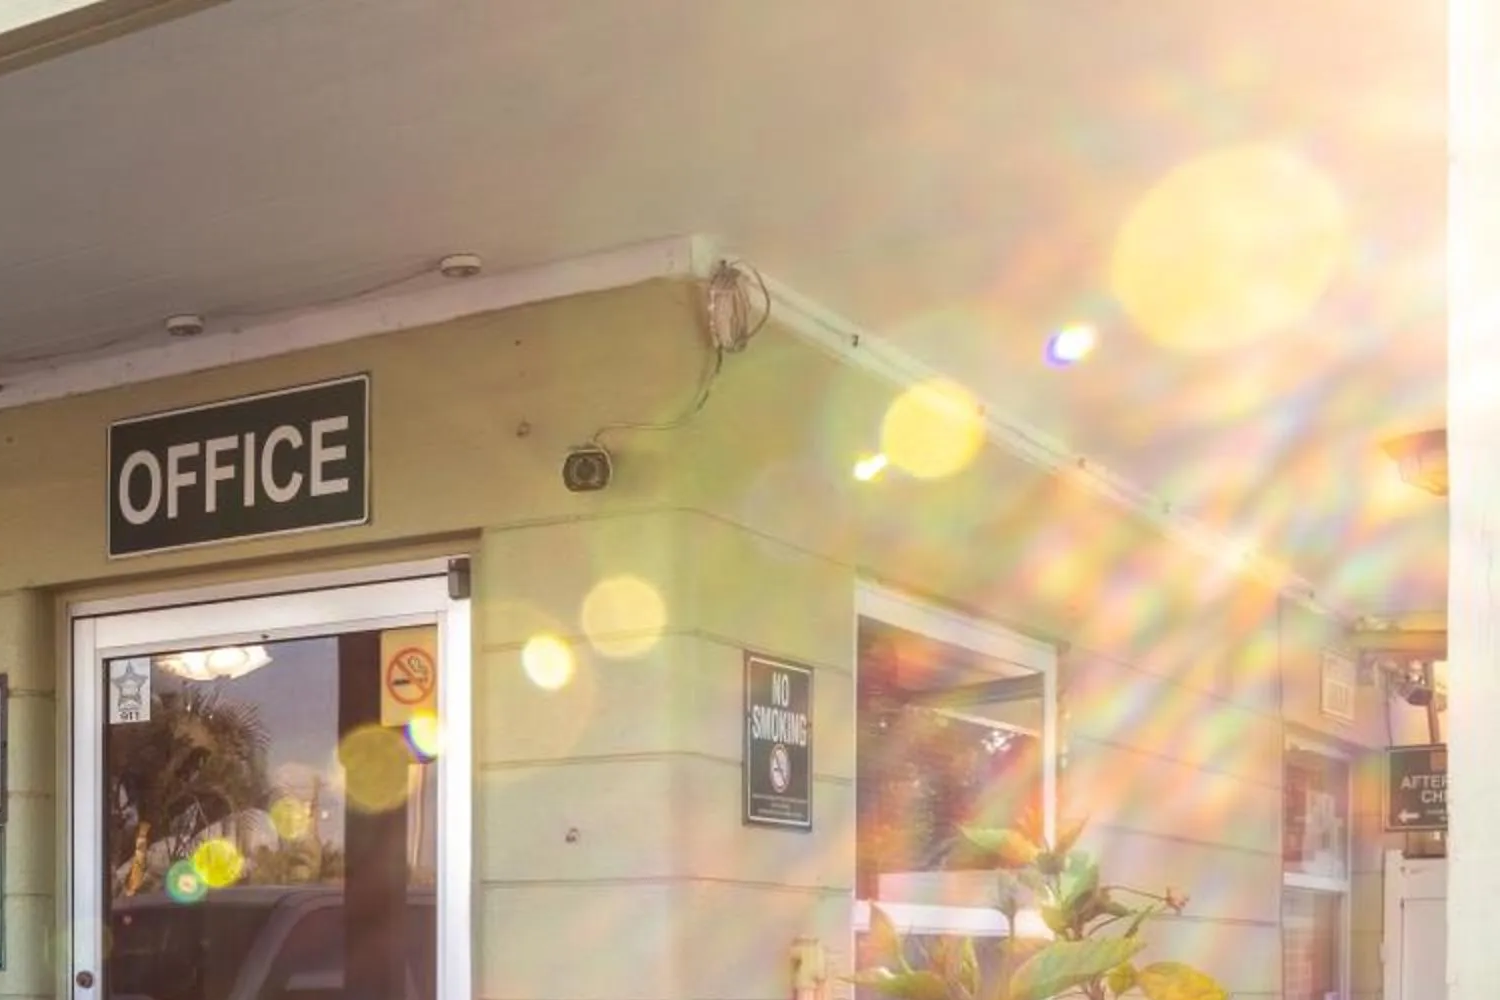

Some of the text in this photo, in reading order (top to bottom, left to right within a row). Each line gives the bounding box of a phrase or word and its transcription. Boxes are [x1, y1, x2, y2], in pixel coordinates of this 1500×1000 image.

[119, 415, 349, 525] OFFICE
[771, 671, 790, 707] NO
[751, 704, 808, 747] SMOKING
[1421, 790, 1446, 803] CH
